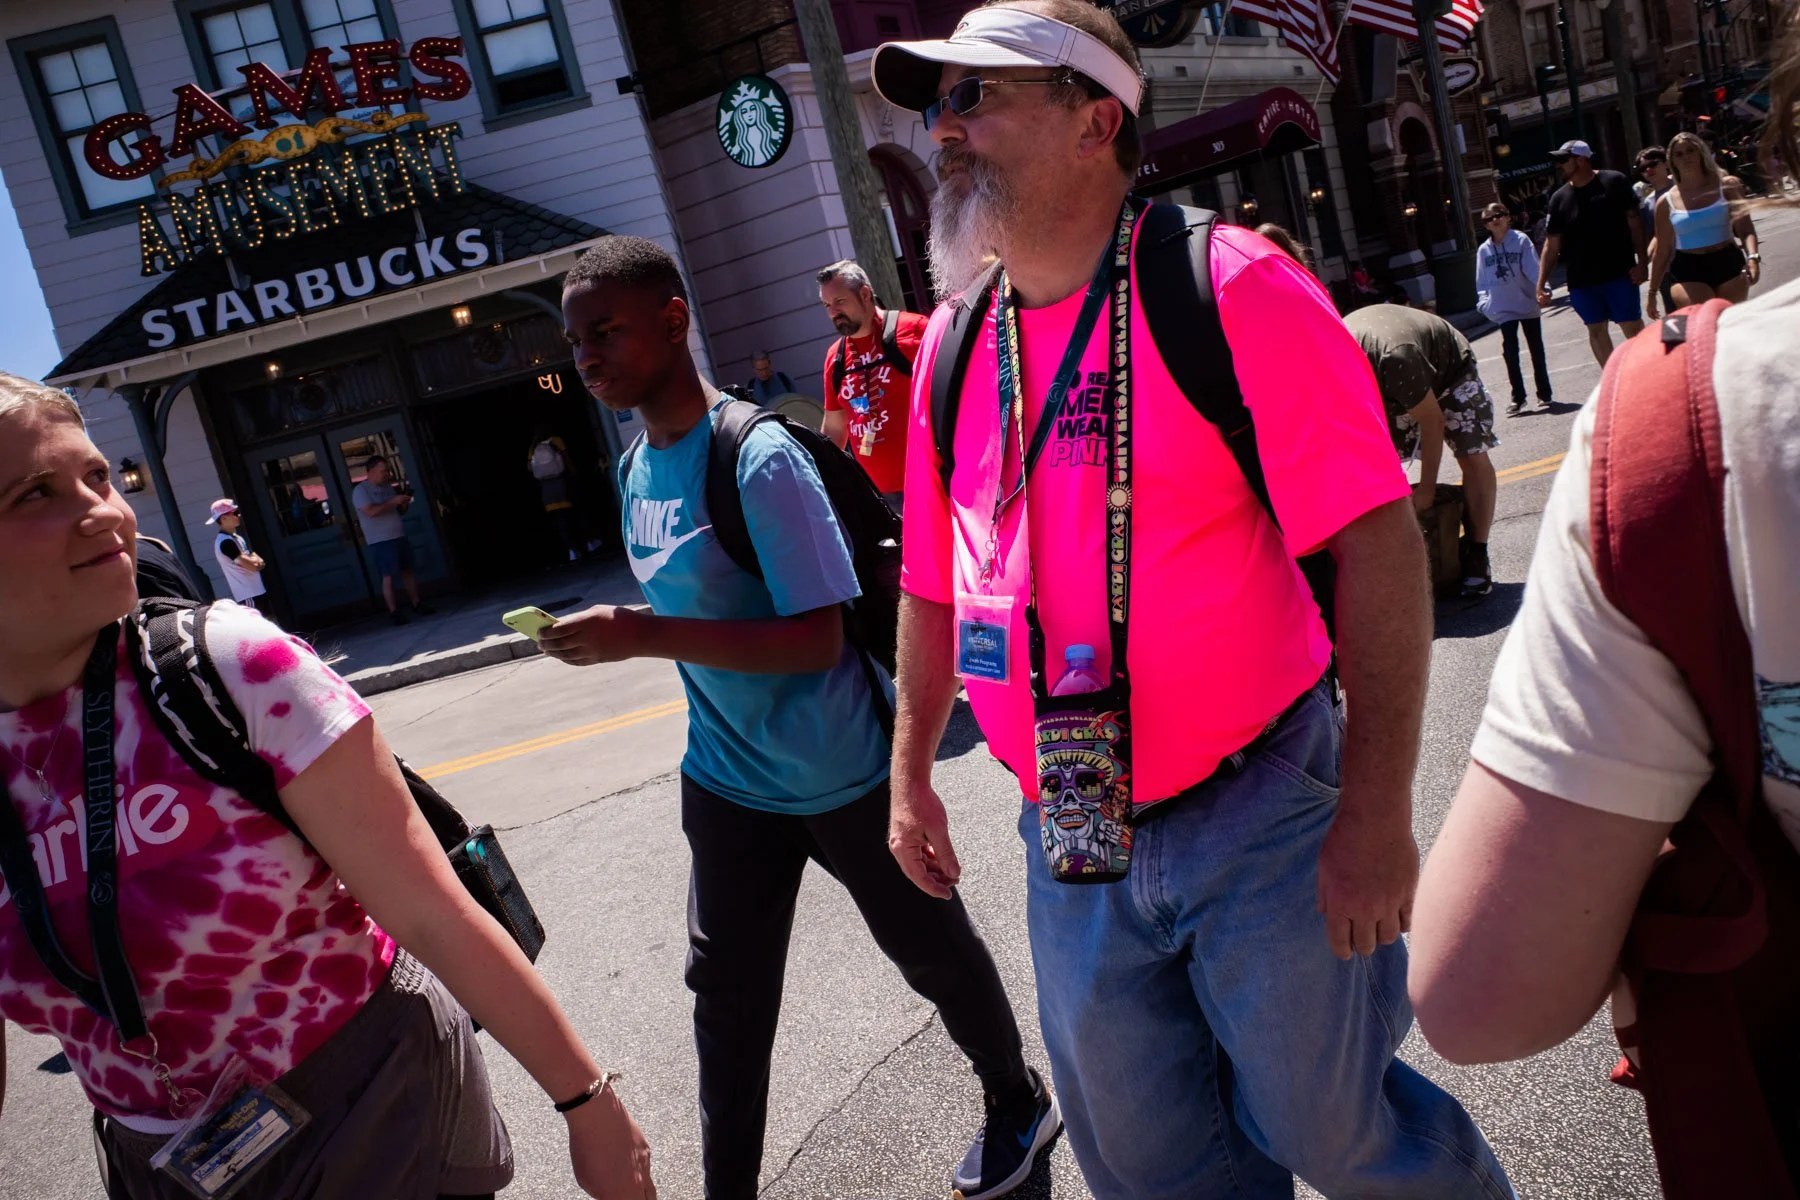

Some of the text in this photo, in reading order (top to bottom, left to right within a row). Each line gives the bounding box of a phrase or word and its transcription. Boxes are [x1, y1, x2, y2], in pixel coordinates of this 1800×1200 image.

[84, 36, 471, 181] GAMES
[1258, 100, 1315, 134] EMPIRE HOTEL
[139, 121, 467, 277] AMUSEMENT
[1137, 162, 1160, 177] TEL
[141, 227, 489, 348] STARBUCKS
[1057, 415, 1108, 440] WEA
[1113, 278, 1129, 483] UNIVERSAL ORLANDO
[631, 497, 683, 550] NIKE
[1110, 512, 1128, 623] MARDI GRAS
[86, 690, 113, 854] SLYTHERIN
[1035, 726, 1115, 747] ARDI GRAS
[0, 783, 190, 908] arie
